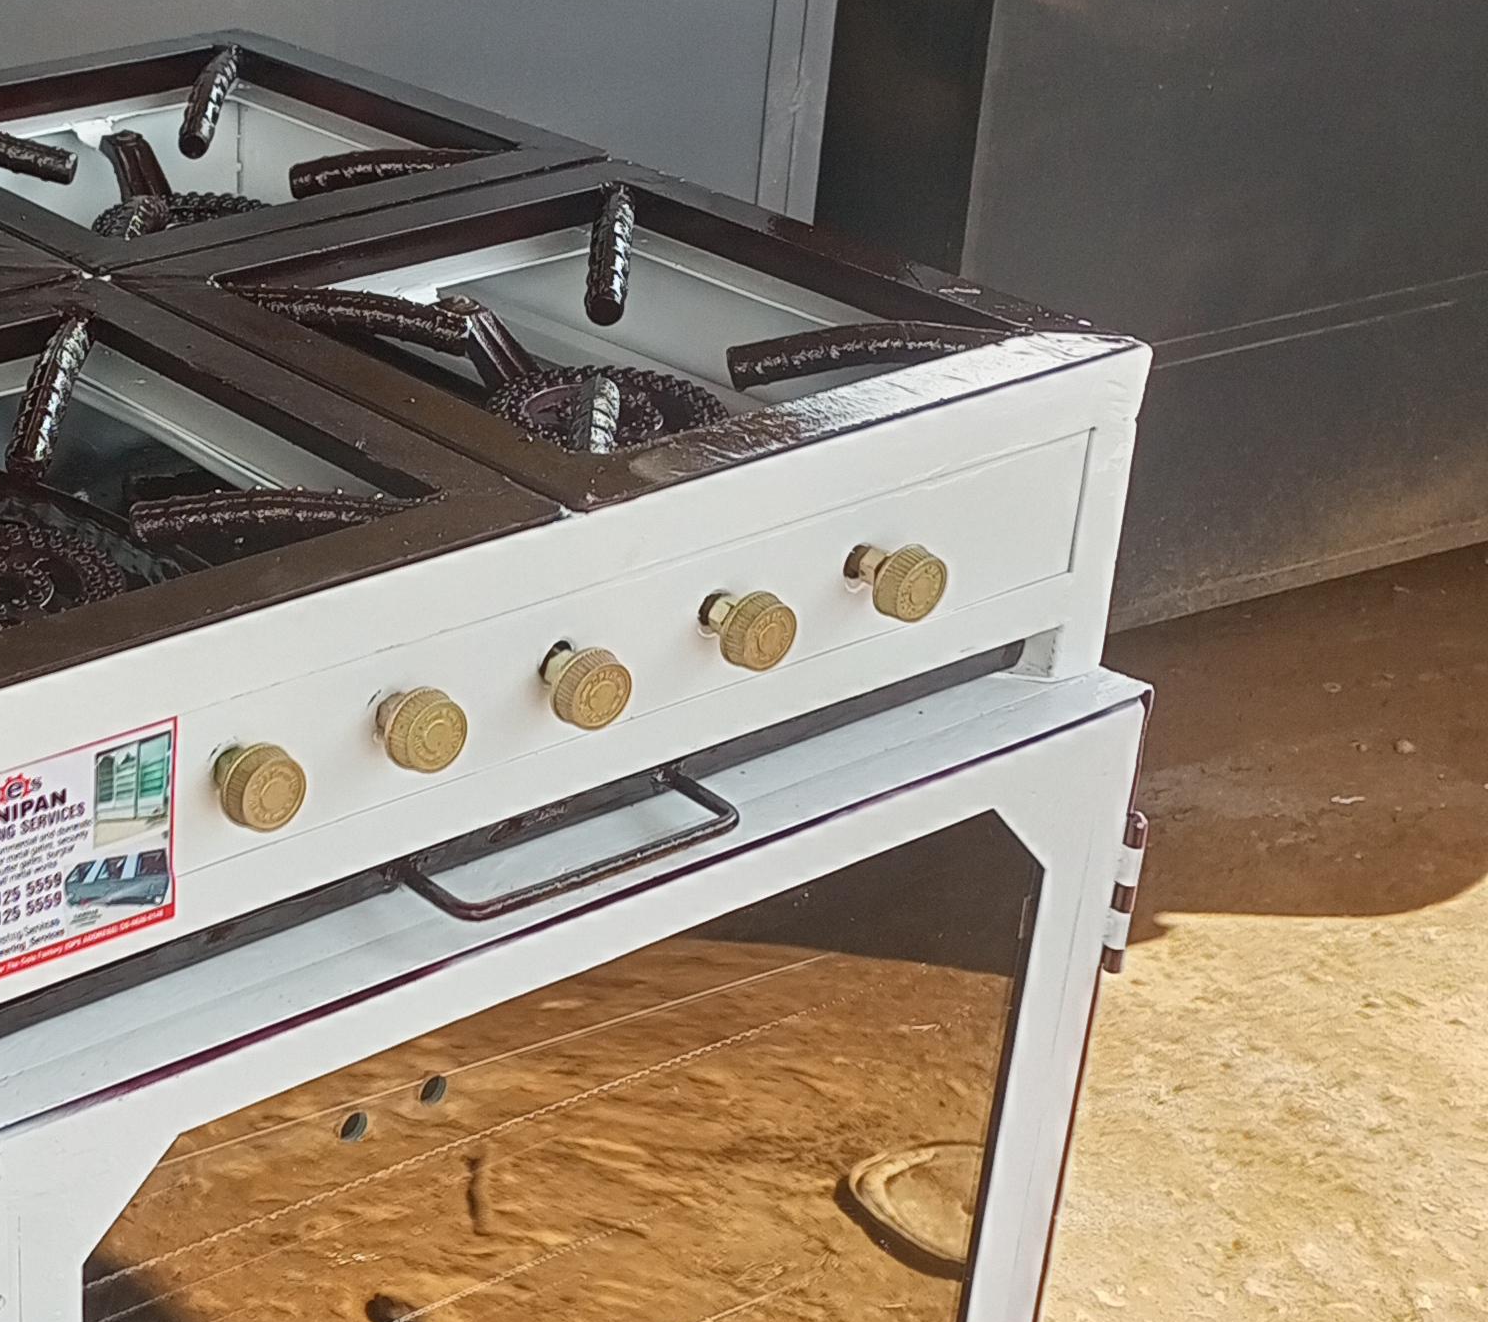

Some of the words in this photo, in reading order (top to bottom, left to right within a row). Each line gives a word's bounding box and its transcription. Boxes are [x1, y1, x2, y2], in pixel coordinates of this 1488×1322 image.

[20, 802, 84, 834] SERVICES
[26, 871, 61, 896] 5559
[26, 891, 61, 915] 5559
